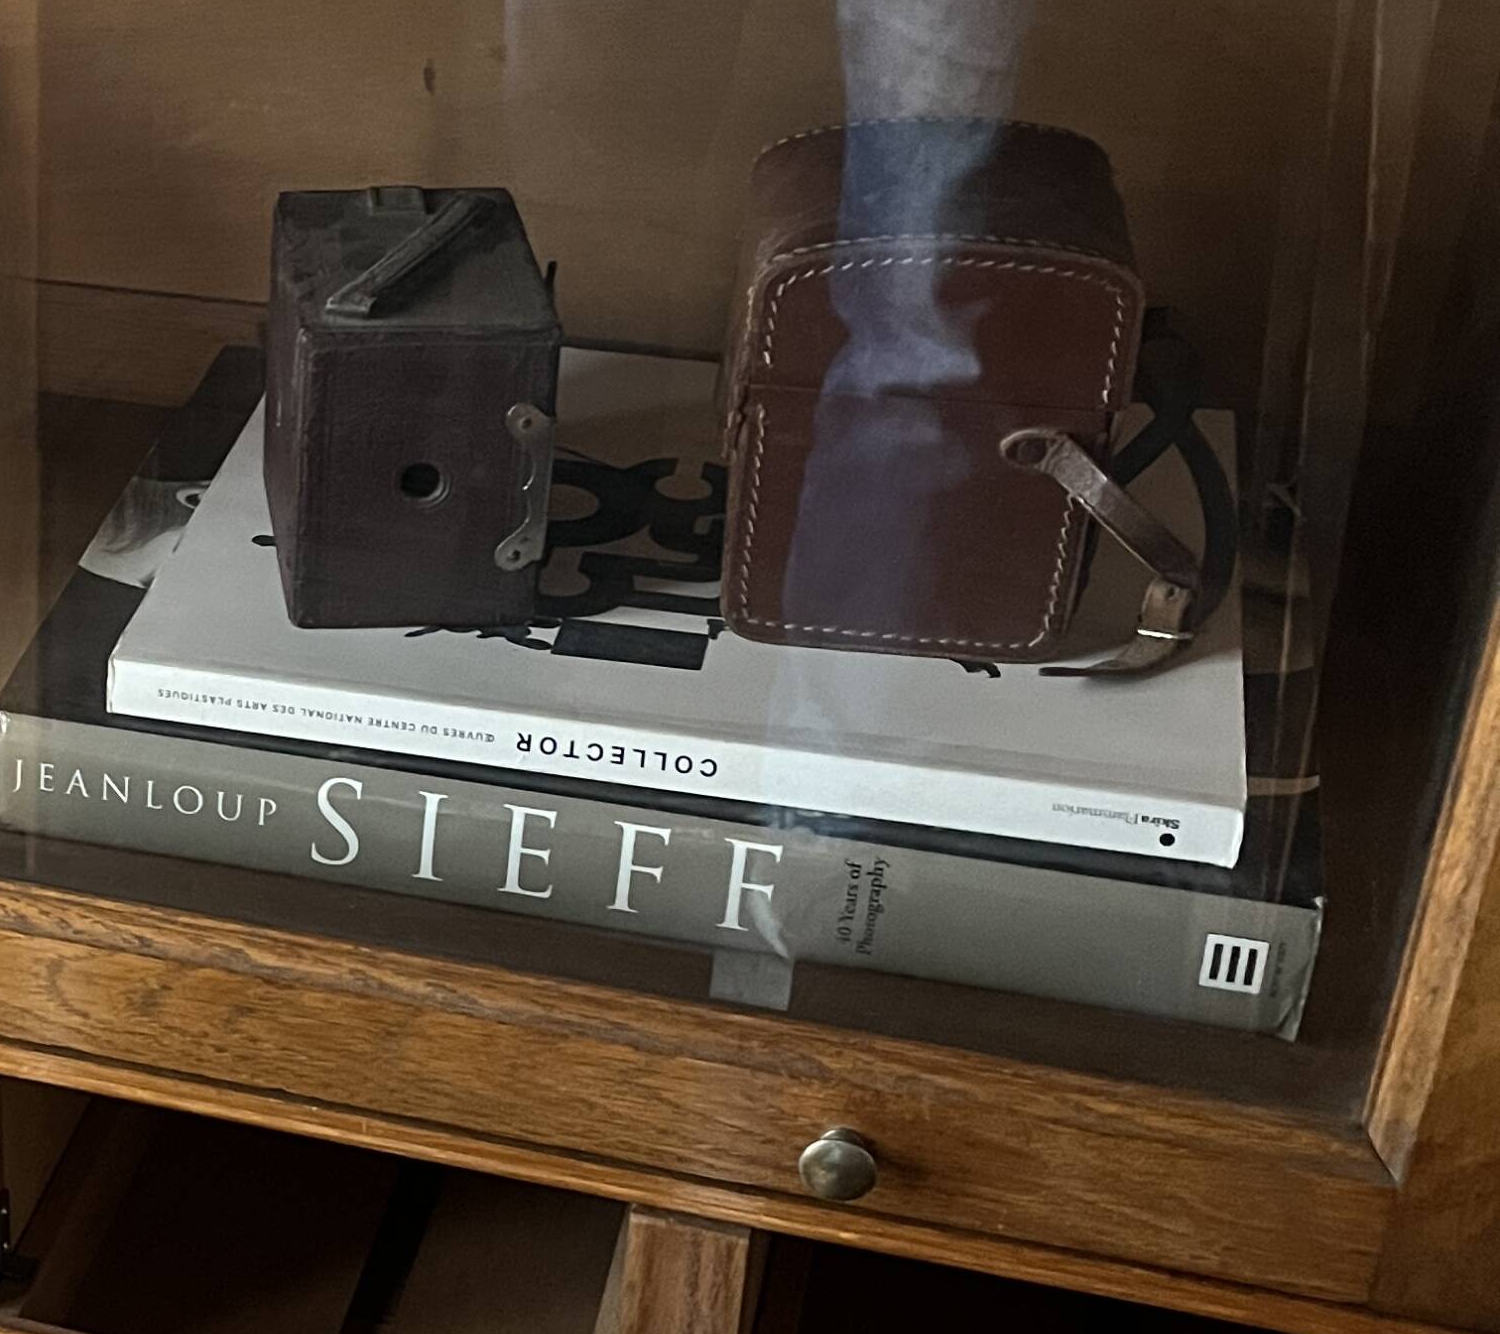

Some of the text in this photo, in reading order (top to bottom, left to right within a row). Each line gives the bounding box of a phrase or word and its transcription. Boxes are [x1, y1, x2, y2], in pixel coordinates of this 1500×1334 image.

[157, 688, 233, 707] PLASTIQUES
[236, 699, 268, 711] ARTS
[272, 703, 296, 715] DES
[299, 707, 363, 724] NATIONAL
[367, 716, 415, 732] CENTRE
[421, 723, 438, 736] DU
[516, 731, 718, 778] COLLECTOR
[1051, 802, 1180, 830] Skira Flammarion
[12, 759, 785, 933] JEANLOUP SIEFF
[844, 857, 862, 880] of
[838, 883, 859, 923] Years
[855, 856, 891, 956] Photography
